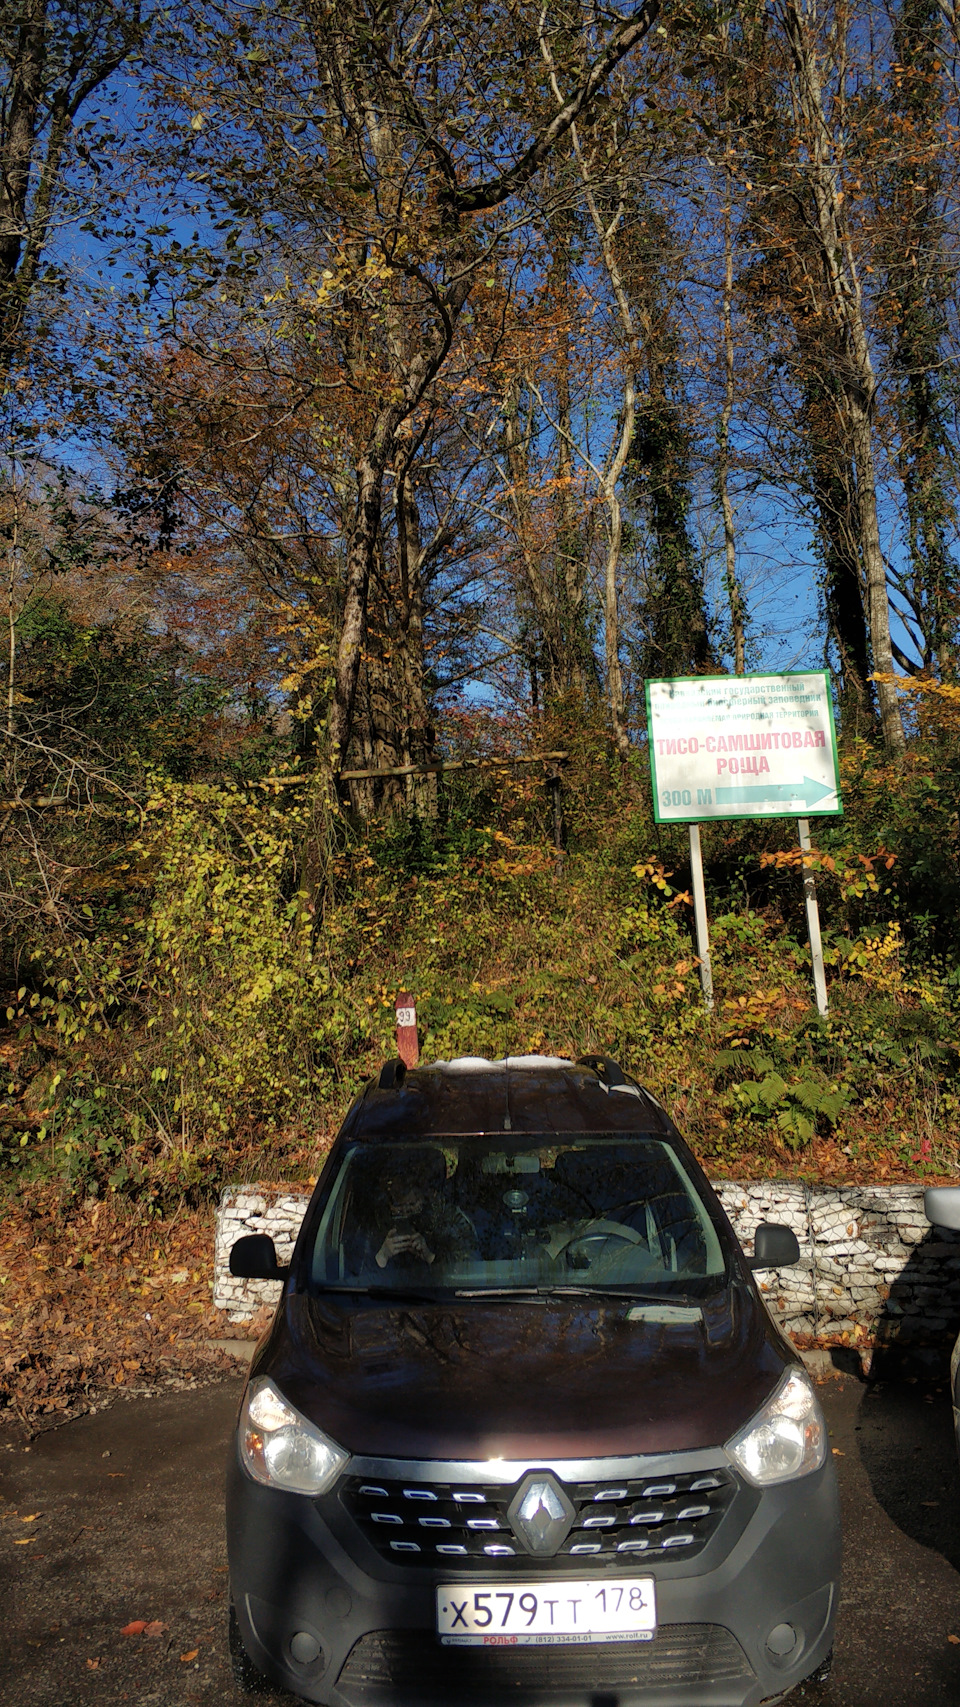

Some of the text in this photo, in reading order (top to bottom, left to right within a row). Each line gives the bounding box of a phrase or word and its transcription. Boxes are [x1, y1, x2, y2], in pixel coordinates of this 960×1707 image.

[724, 683, 804, 698] государственный
[768, 694, 821, 704] заповедник
[776, 709, 819, 719] ТЕРРИТОРИЯ
[656, 730, 826, 755] ТИСО-САМШИТОВАЯ
[716, 756, 770, 776] РОЩА
[661, 790, 691, 807] 300
[398, 1010, 411, 1022] 99
[595, 1586, 644, 1612] 178
[482, 1635, 519, 1645] РОЛЬФ
[535, 1634, 592, 1643] (812) 334-01-01
[605, 1632, 648, 1641] www.rolf.ru
